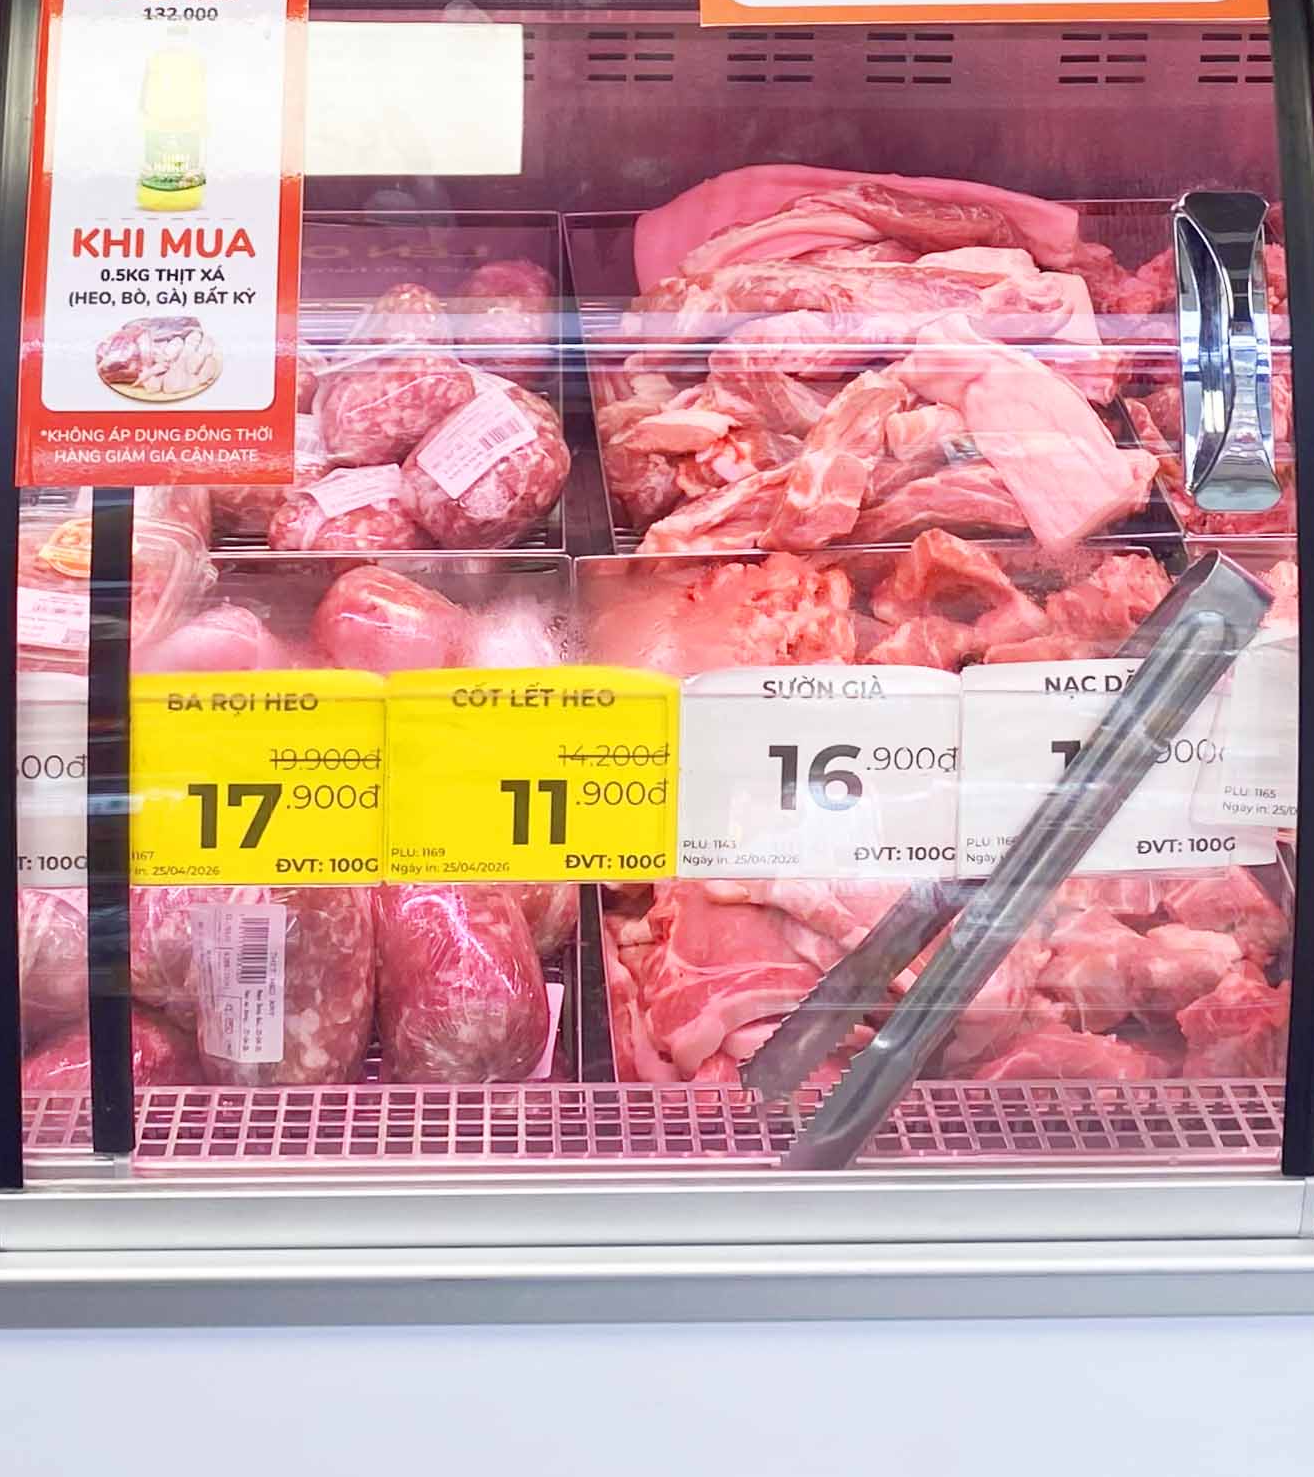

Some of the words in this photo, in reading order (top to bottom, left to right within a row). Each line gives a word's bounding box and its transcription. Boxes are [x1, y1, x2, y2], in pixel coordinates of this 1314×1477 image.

[72, 228, 145, 259] KHI
[160, 228, 256, 259] MUA
[100, 268, 150, 283] 0.5KG
[155, 268, 195, 285] THỊT
[200, 265, 225, 283] XÁ
[69, 291, 116, 307] (HEO,
[122, 287, 151, 307] BÒ,
[156, 287, 188, 307] GÀ)
[194, 285, 227, 305] BẤT
[233, 285, 256, 305] KỲ
[108, 425, 130, 442] ÁP
[135, 429, 180, 445] DỤNG
[185, 424, 232, 442] ĐỒNG
[236, 425, 273, 442] THỜI
[54, 446, 101, 463] HÀNG
[105, 446, 145, 463] GIẢM
[150, 446, 176, 463] GIÁ
[180, 448, 214, 464] CẬN
[218, 449, 257, 462] DATE
[452, 683, 503, 708] CỐT
[511, 682, 554, 708] LẾT
[563, 689, 616, 708] HEO
[762, 676, 834, 699] SƯỜN
[211, 692, 256, 715] RỌI
[265, 692, 319, 712] HEO
